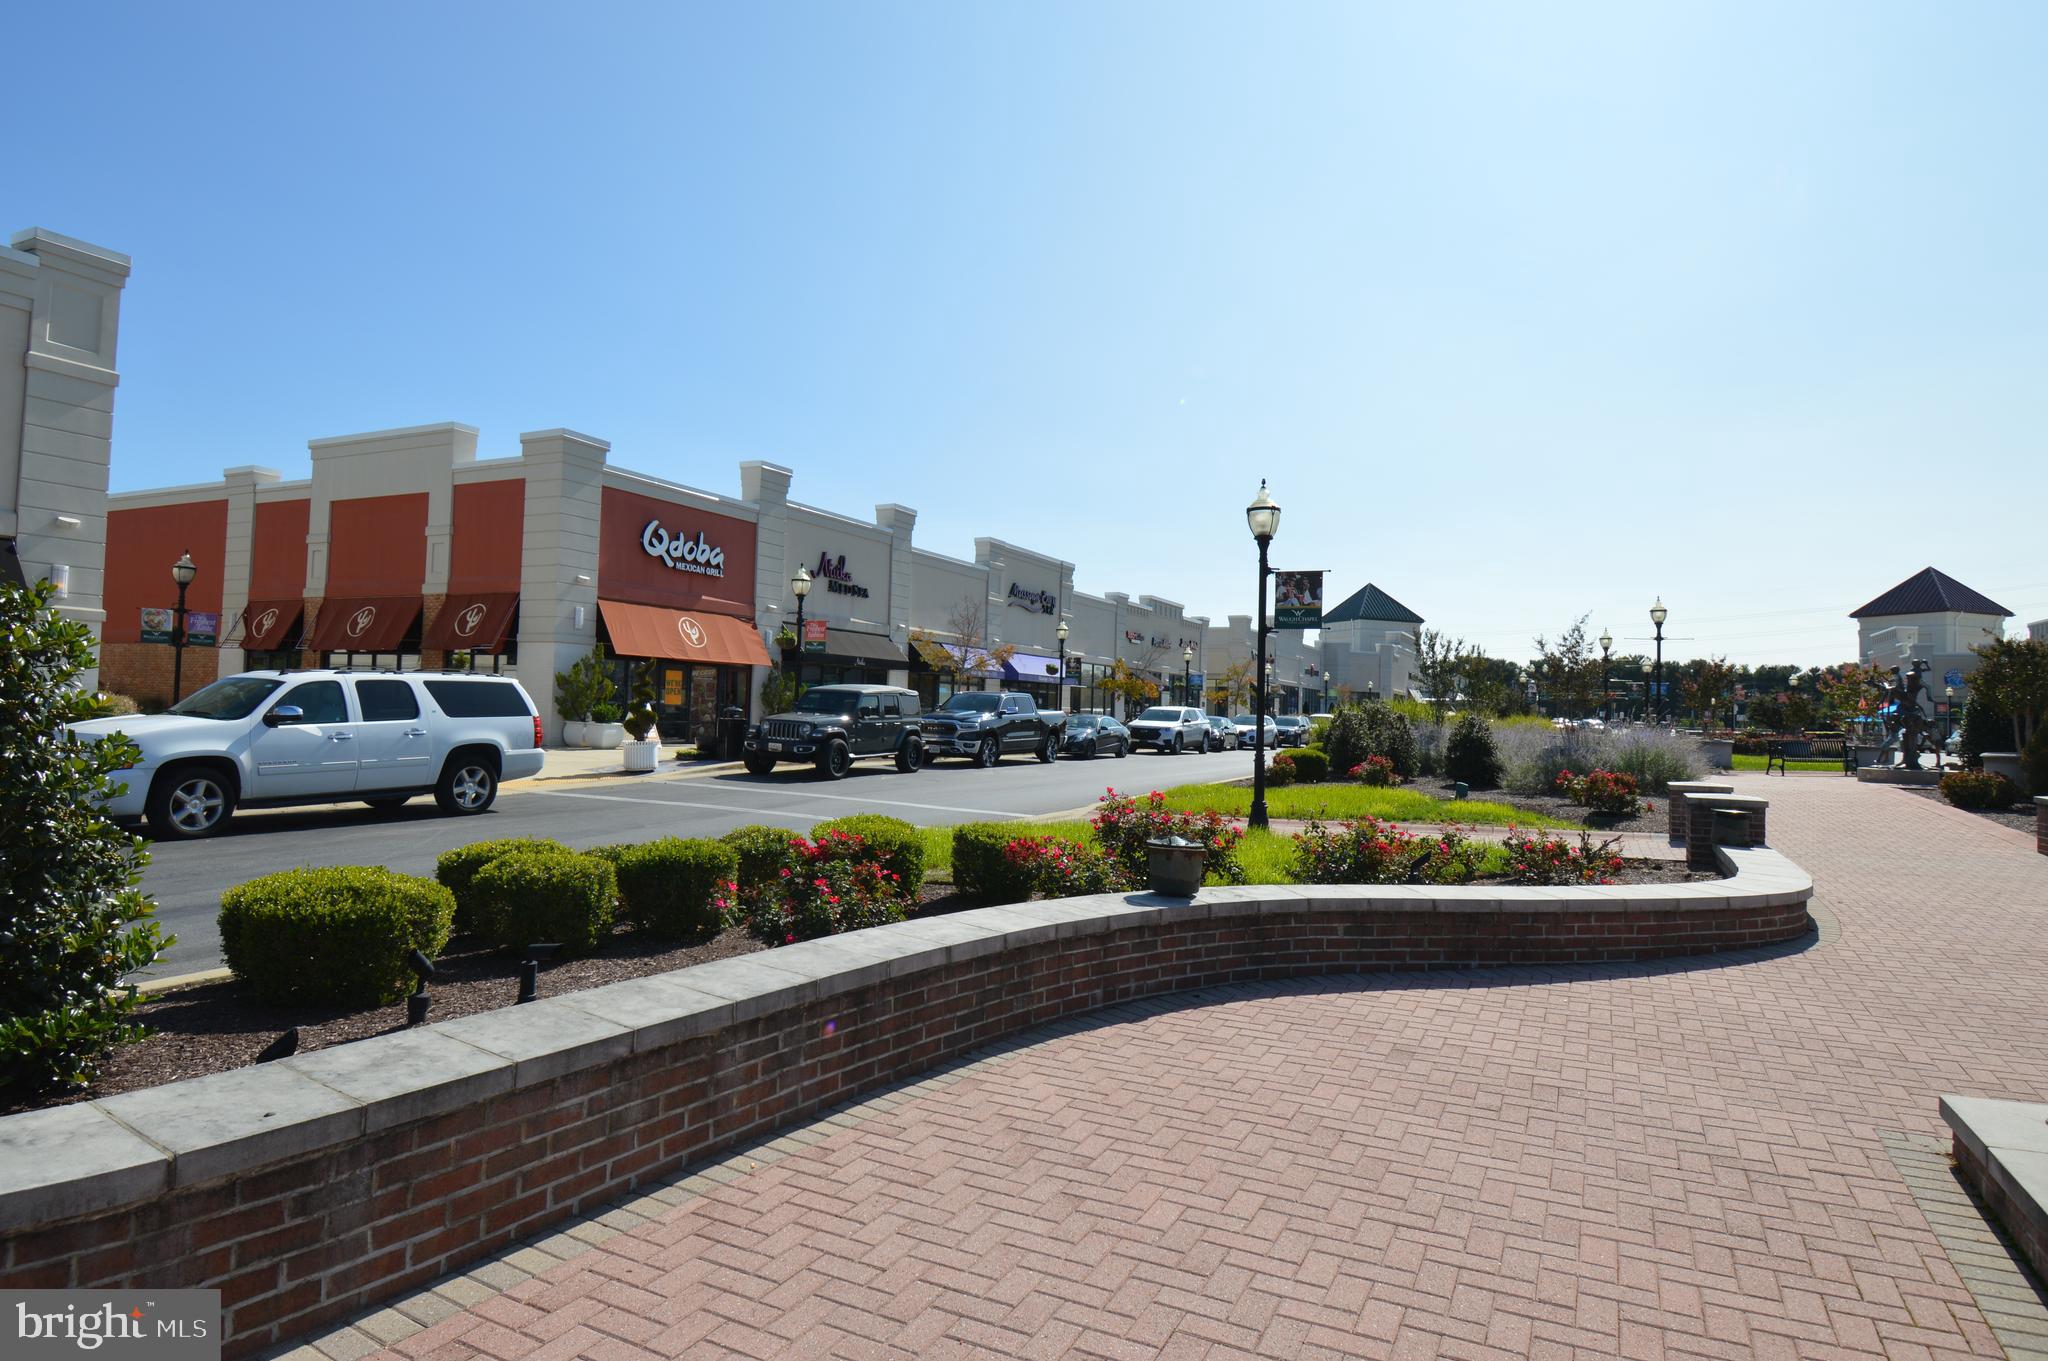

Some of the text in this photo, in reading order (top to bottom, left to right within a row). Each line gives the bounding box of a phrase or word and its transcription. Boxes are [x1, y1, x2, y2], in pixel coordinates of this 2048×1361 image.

[642, 519, 724, 569] Qdoba
[675, 561, 724, 578] MEXICAN GRILL
